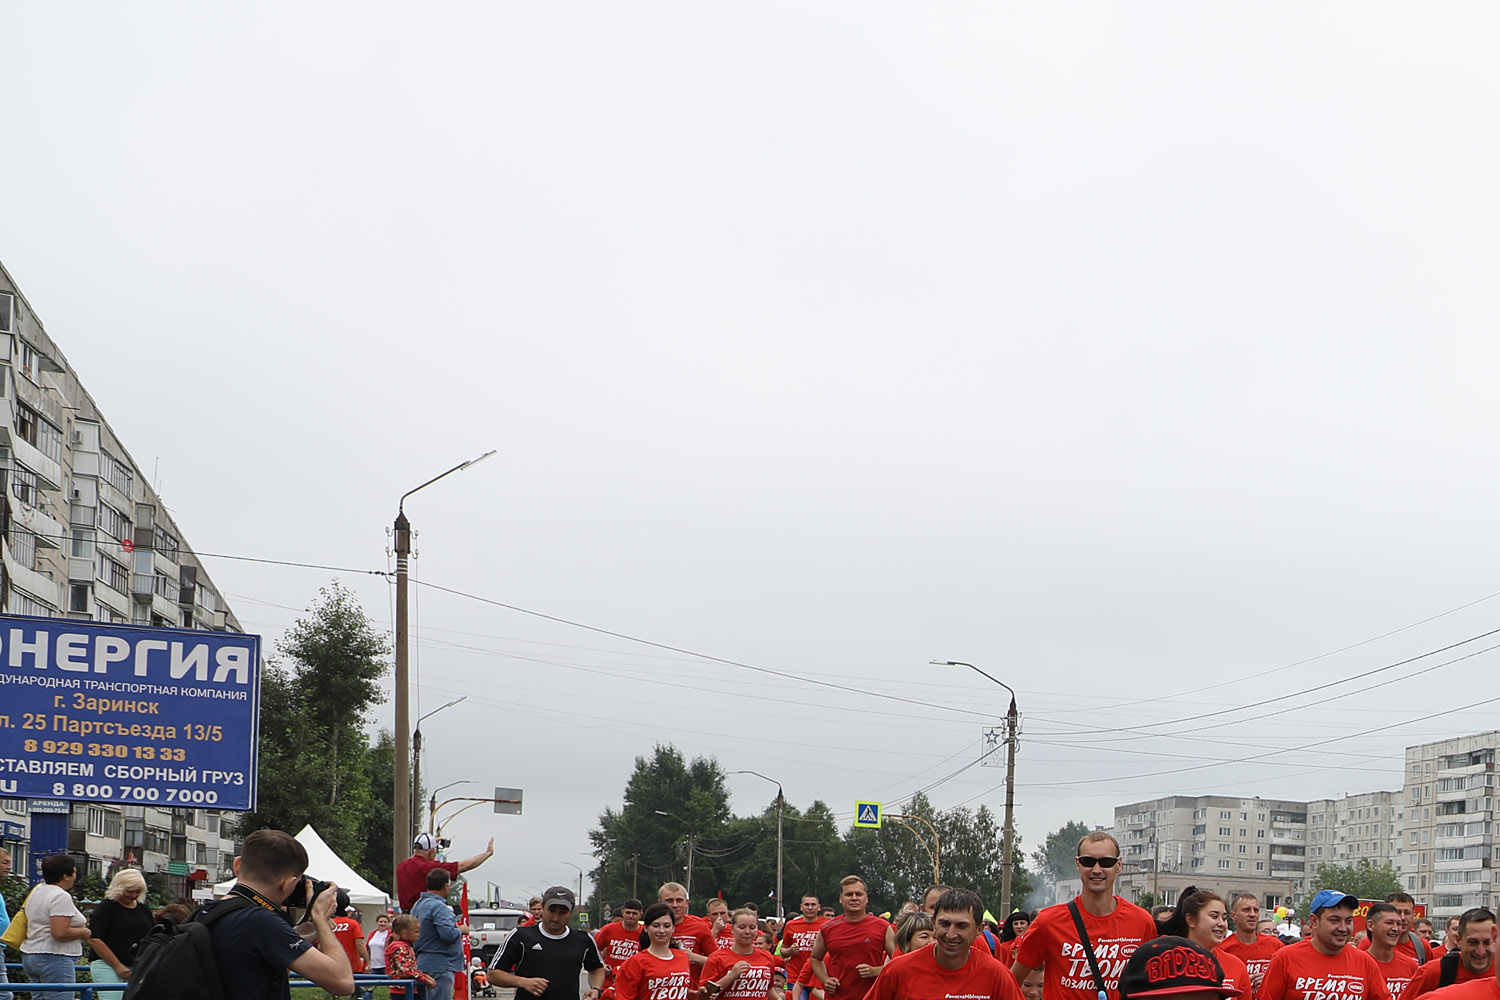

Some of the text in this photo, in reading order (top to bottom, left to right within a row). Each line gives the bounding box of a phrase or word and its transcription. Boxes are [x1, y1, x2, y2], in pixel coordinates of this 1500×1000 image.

[0, 628, 249, 684] НЕРГИЯ
[84, 680, 178, 696] ТРАНСПОРТНАЯ
[181, 687, 248, 700] КОМПАНИЯ
[54, 692, 159, 714] г. Заринск
[22, 713, 46, 730] 25
[53, 715, 176, 740] Партсъезда
[183, 724, 223, 741] 13/5
[24, 739, 186, 761] 8 929 330 13 33
[104, 765, 197, 783] СБОРНЫЙ
[202, 770, 244, 785] ГРУЗ
[53, 783, 65, 796] 8
[72, 784, 113, 798] 800
[120, 786, 159, 801] 700
[166, 788, 218, 804] 7000
[32, 800, 64, 808] АРЕНДА
[1068, 958, 1129, 978] ТВОИ
[648, 975, 684, 990] ВРЕМЯ
[1295, 977, 1347, 992] ВРЕМЯ
